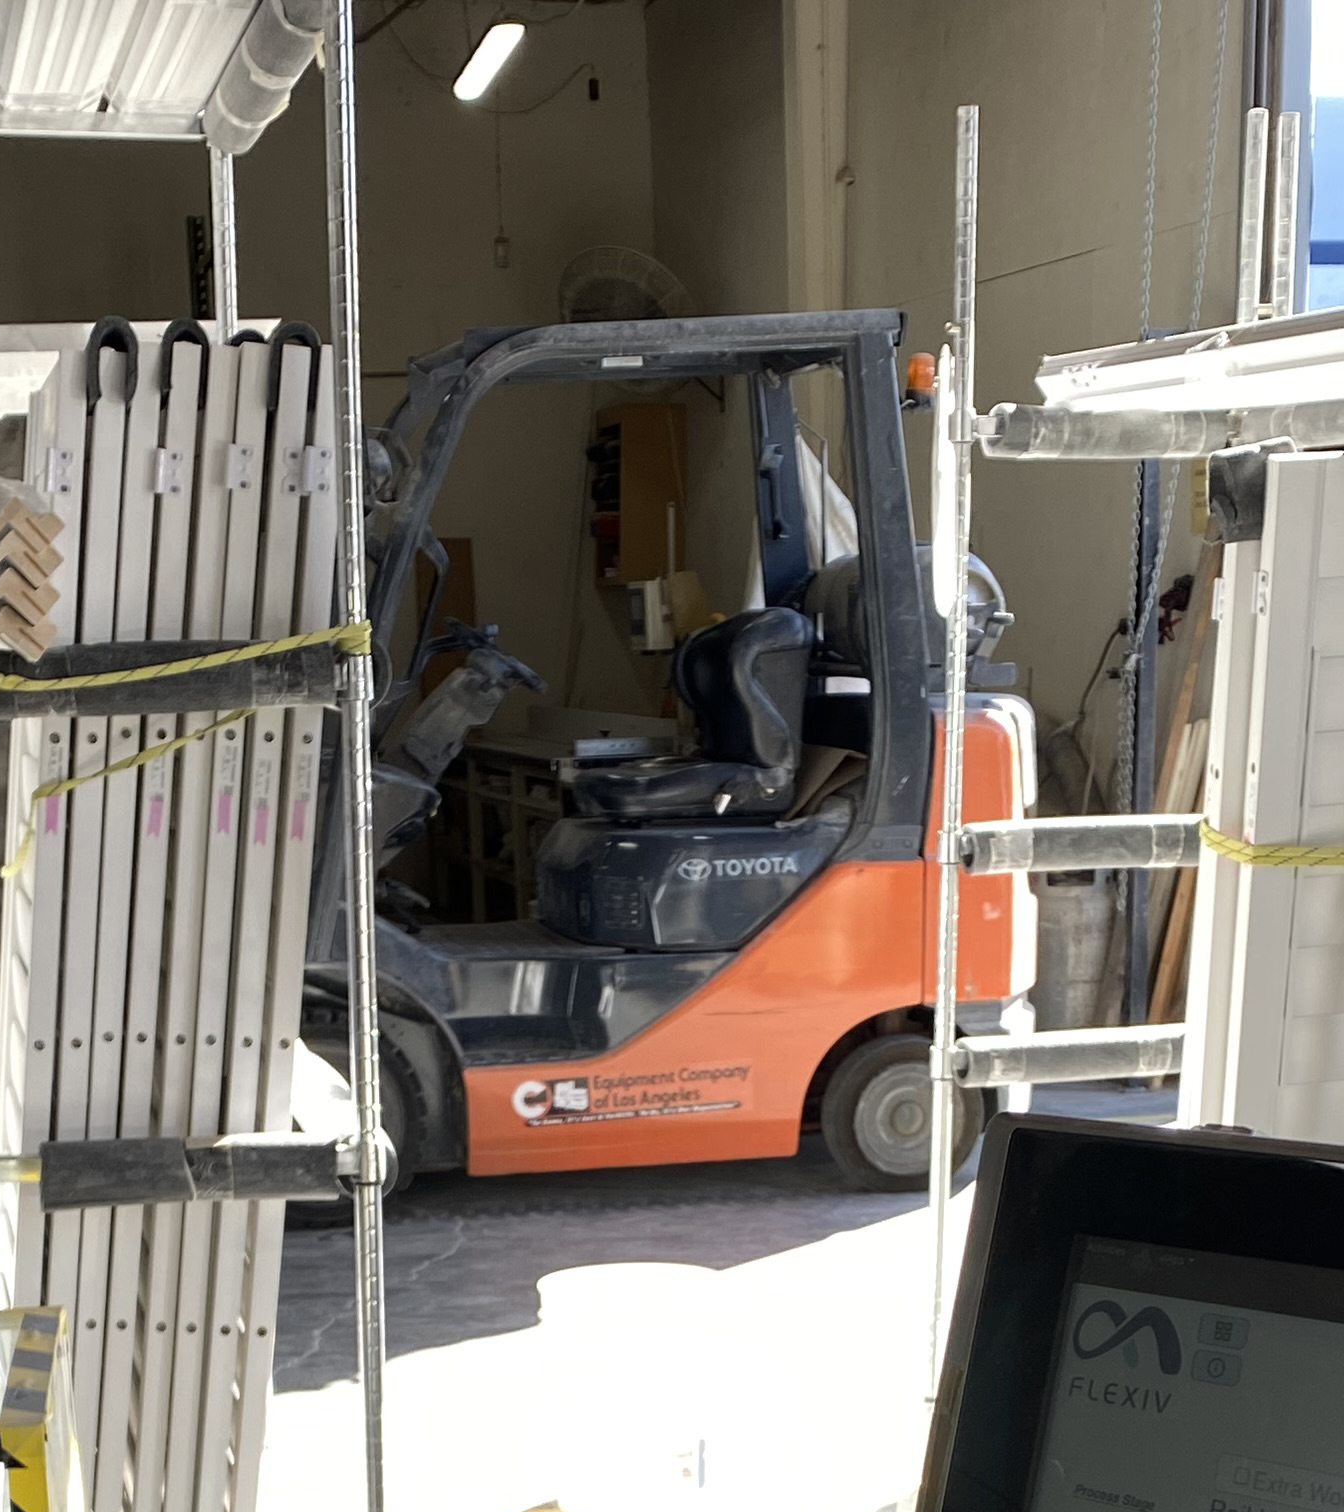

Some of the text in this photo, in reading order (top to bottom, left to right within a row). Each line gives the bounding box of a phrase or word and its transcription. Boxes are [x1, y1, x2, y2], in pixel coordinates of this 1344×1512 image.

[712, 856, 797, 877] TOYOTA
[593, 1065, 749, 1094] Equipment Company
[594, 1087, 700, 1110] of Los Angeles
[1068, 1376, 1173, 1414] FLEXIV
[1074, 1483, 1120, 1505] Process
[1253, 1471, 1303, 1498] Extra
